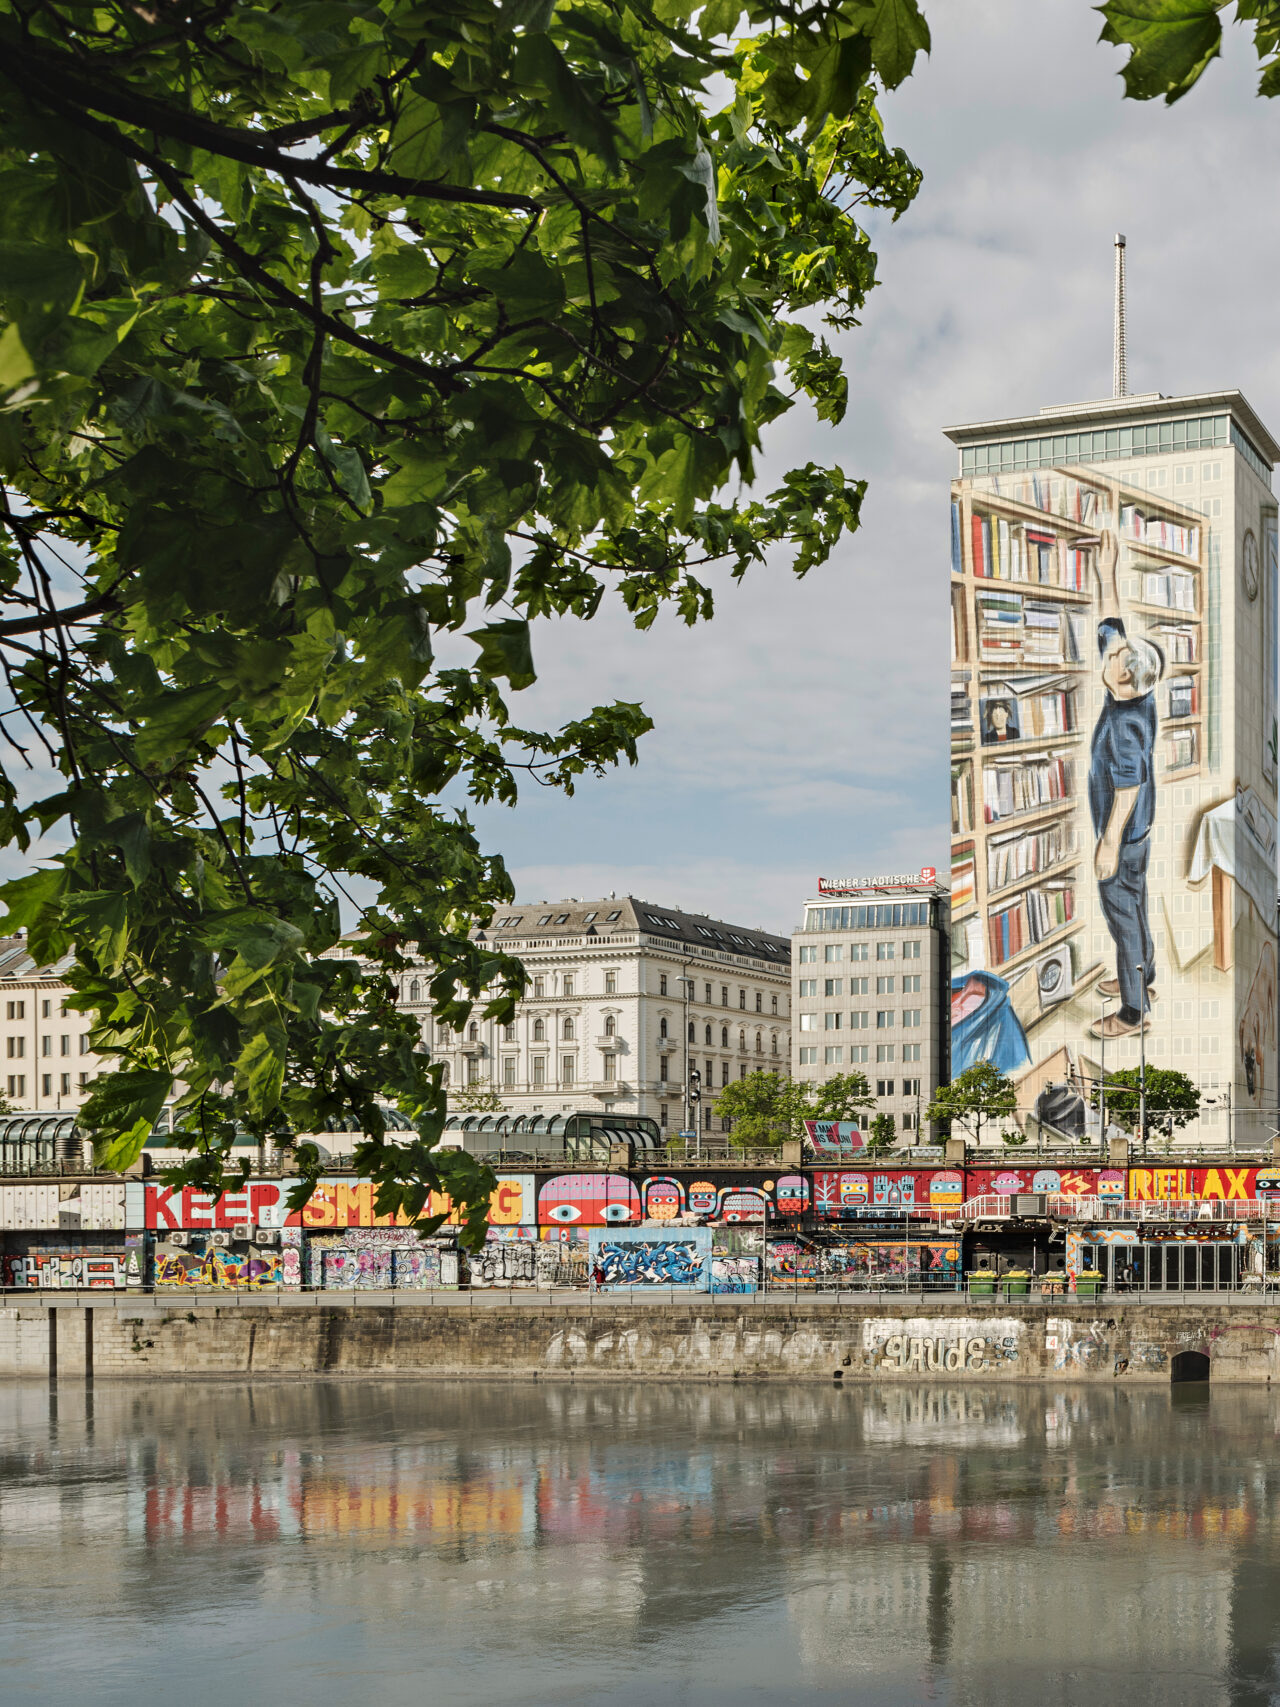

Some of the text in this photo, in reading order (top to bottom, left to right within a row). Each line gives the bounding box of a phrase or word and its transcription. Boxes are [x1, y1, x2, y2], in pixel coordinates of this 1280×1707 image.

[820, 878, 859, 889] WIENER
[818, 1124, 834, 1133] MAI
[812, 1134, 826, 1143] BIS
[836, 1135, 852, 1144] JUNI
[1129, 1169, 1250, 1200] RELAX
[145, 1184, 280, 1229] KEEP
